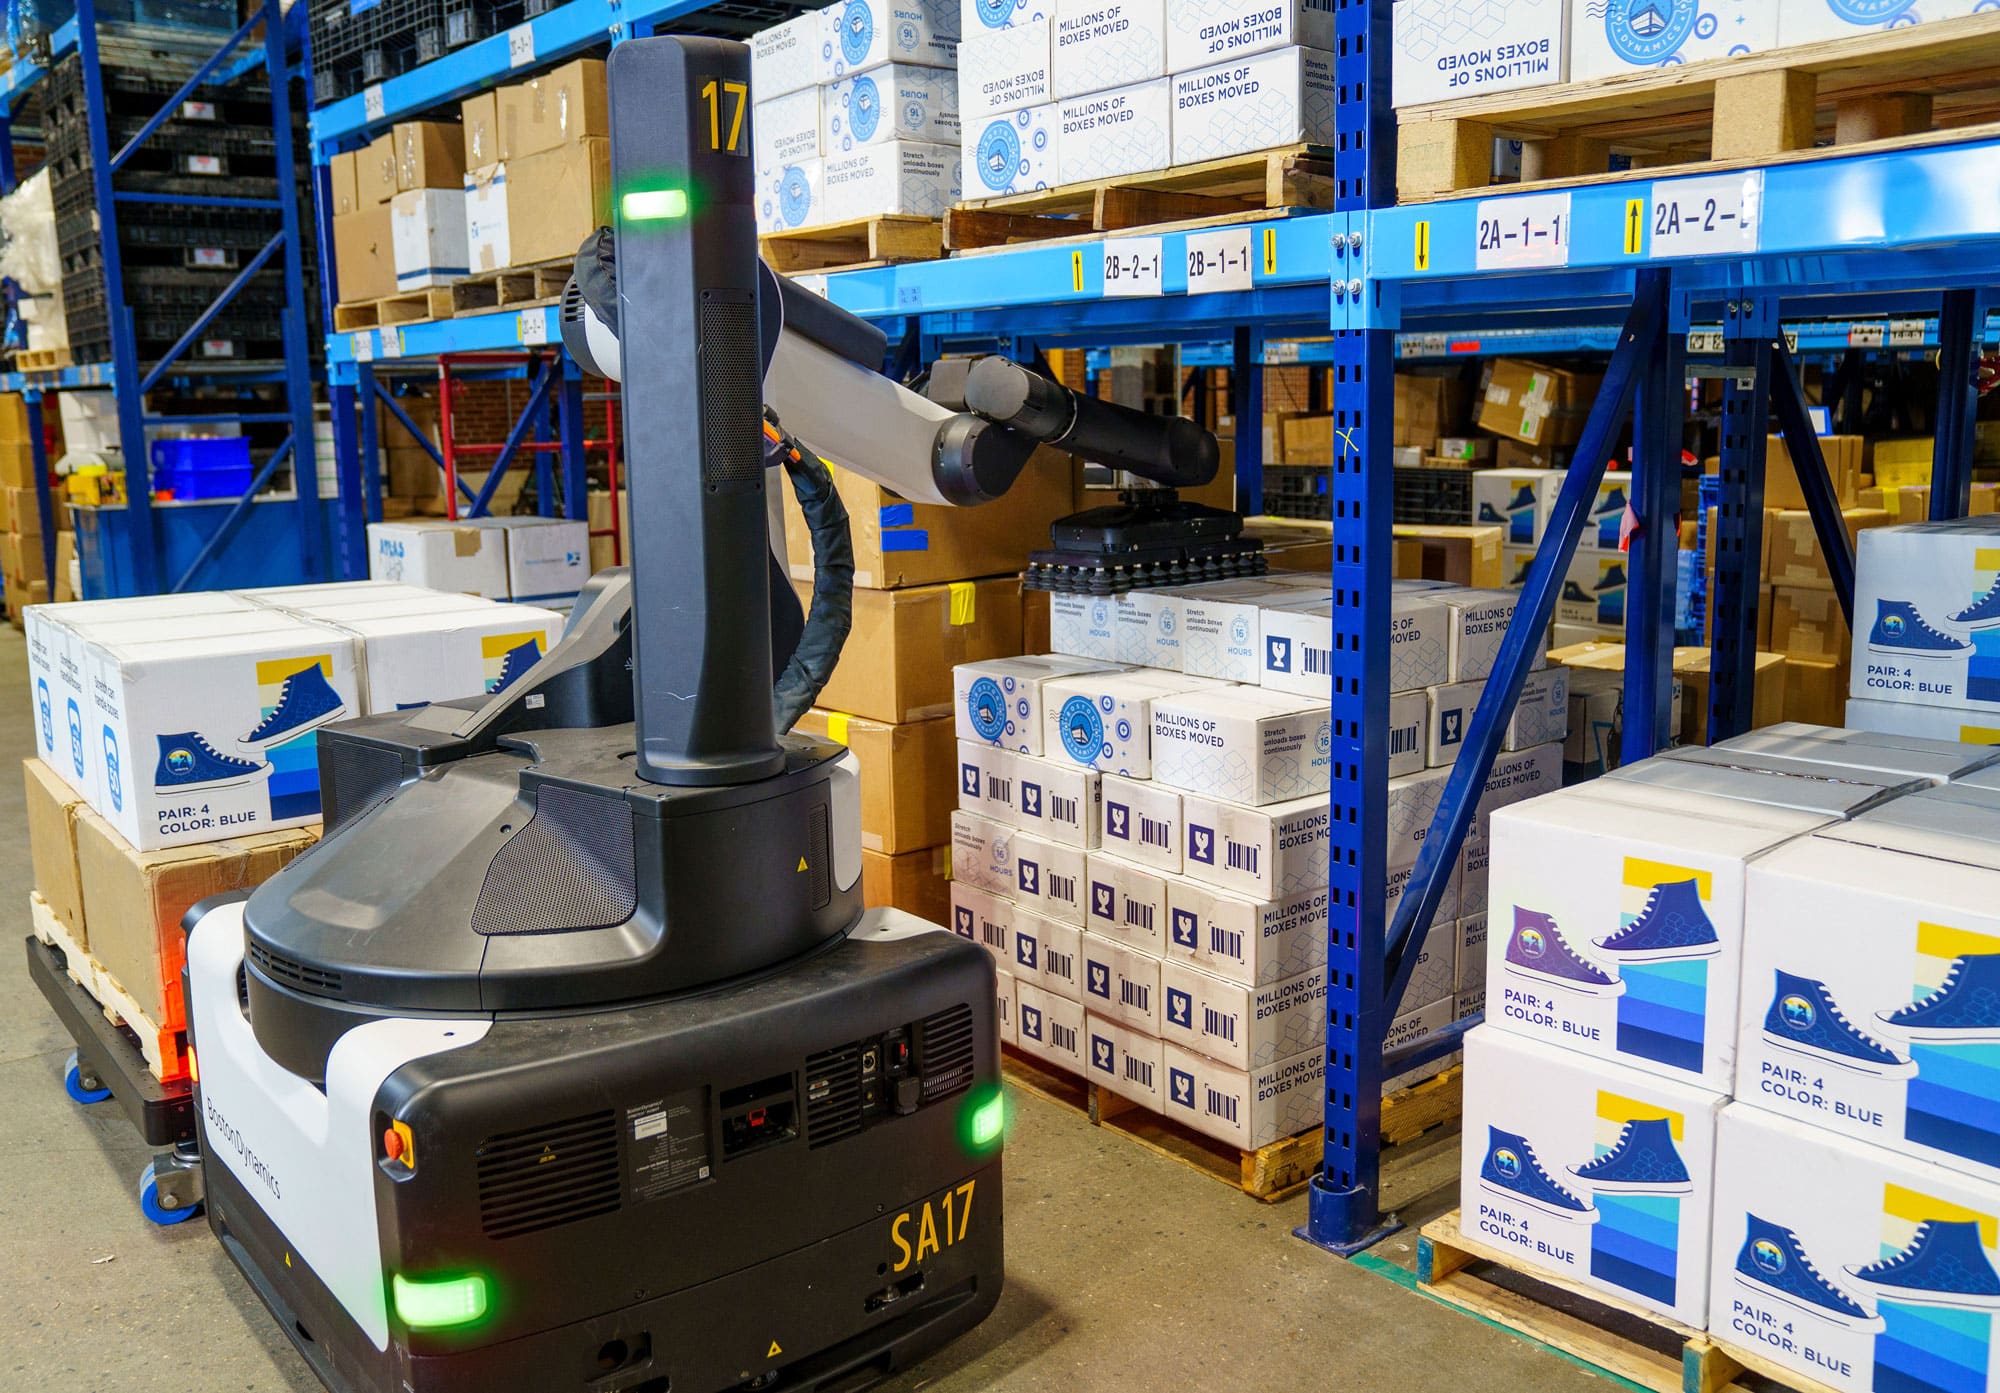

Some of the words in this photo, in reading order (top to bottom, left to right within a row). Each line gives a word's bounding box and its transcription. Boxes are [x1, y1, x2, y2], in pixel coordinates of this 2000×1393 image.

[1060, 11, 1104, 32] MILLIONS
[1108, 6, 1121, 20] OF
[1244, 6, 1282, 23] BOXES
[756, 30, 782, 45] MILLIONS
[784, 28, 792, 38] OF
[1060, 29, 1090, 46] BOXES
[1094, 19, 1129, 38] MOVED
[1200, 19, 1240, 40] MOVED
[1227, 23, 1282, 45] MILLIONS
[1620, 25, 1680, 53] DYNAMICS
[756, 44, 776, 59] BOXES
[776, 38, 797, 55] MOVED
[1208, 40, 1224, 54] OF
[1497, 38, 1550, 60] BOXES
[1305, 59, 1328, 70] Stretch
[1438, 48, 1492, 71] MOVED
[1016, 69, 1044, 86] BOXES
[1305, 70, 1330, 82] unloads
[1449, 71, 1470, 87] OF
[1475, 57, 1549, 82] MILLIONS
[982, 78, 1013, 95] MOVED
[1178, 72, 1230, 94] MILLIONS
[1234, 67, 1250, 82] OF
[990, 94, 1002, 106] OF
[1004, 84, 1044, 102] MILLIONS
[1179, 91, 1214, 110] BOXES
[1218, 81, 1260, 101] MOVED
[702, 80, 748, 152] 17
[1063, 100, 1108, 121] MILLIONS
[1112, 96, 1126, 110] OF
[1064, 117, 1094, 134] BOXES
[1098, 110, 1134, 127] MOVED
[826, 158, 857, 172] MILLIONS
[858, 156, 868, 168] OF
[902, 152, 924, 160] Stretch
[902, 160, 926, 168] unloads
[927, 161, 944, 170] boxes
[827, 172, 849, 185] BOXES
[850, 167, 874, 182] MOVED
[903, 168, 940, 178] continuously
[1480, 214, 1560, 250] 2A-1-1
[1106, 254, 1158, 280] 2B-2-1
[1189, 246, 1248, 277] 2B-1-1
[1400, 618, 1414, 630] OF
[1465, 608, 1505, 622] MILLIONS
[1162, 620, 1172, 630] 16
[1235, 628, 1244, 638] 16
[1466, 621, 1494, 636] BOXES
[1156, 638, 1180, 648] HOURS
[1228, 647, 1252, 657] HOURS
[1867, 665, 1900, 677] PAIR:
[1903, 668, 1912, 678] 4
[1867, 678, 1914, 690] COLOR:
[1918, 682, 1952, 694] BLUE
[1066, 704, 1096, 722] BOSTON
[1155, 712, 1200, 730] MILLIONS
[1202, 720, 1216, 732] OF
[1156, 724, 1186, 740] BOXES
[1189, 732, 1224, 748] MOVED
[1264, 728, 1286, 737] Stretch
[1264, 736, 1288, 747] unloads
[1288, 733, 1306, 742] boxes
[1320, 737, 1329, 746] 16
[1067, 736, 1097, 755] DYNAMICS
[1264, 742, 1302, 756] continuously
[1524, 760, 1536, 770] OF
[1485, 779, 1511, 792] BOXES
[1512, 770, 1540, 784] MOVED
[158, 806, 196, 821] PAIR:
[200, 804, 210, 814] 4
[160, 818, 216, 835] COLOR:
[220, 811, 256, 826] BLUE
[1279, 814, 1328, 836] MILLIONS
[1280, 833, 1314, 850] BOXES
[1468, 846, 1489, 860] MILLI
[1468, 858, 1489, 872] BOXE
[1264, 900, 1310, 924] MILLIONS
[1314, 895, 1327, 908] OF
[1264, 920, 1297, 938] BOXES
[1300, 907, 1328, 926] MOVE
[1466, 920, 1488, 935] MILLI
[1466, 932, 1488, 948] BOXE
[1256, 982, 1304, 1006] MILLIONS
[1307, 974, 1321, 990] OF
[1460, 991, 1486, 1008] MILLIO
[1504, 988, 1540, 1008] PAIR:
[1544, 1000, 1554, 1012] 4
[1257, 1000, 1290, 1020] BOXES
[1409, 1016, 1422, 1030] OF
[1504, 1006, 1558, 1030] COLOR:
[1563, 1020, 1600, 1041] BLUE
[1258, 1064, 1305, 1088] MILLIONS
[1308, 1055, 1322, 1072] OF
[1761, 1061, 1807, 1086] PAIR:
[1813, 1078, 1824, 1090] 4
[1258, 1082, 1292, 1102] BOXES
[1761, 1080, 1828, 1110] COLOR:
[1835, 1102, 1884, 1127] BLUE
[207, 1097, 281, 1200] BostonDynamics
[891, 1178, 976, 1272] SA17
[1480, 1204, 1516, 1227] PAIR:
[1520, 1220, 1529, 1231] 4
[1480, 1220, 1532, 1248] COLOR:
[1537, 1242, 1574, 1264] BLUE
[1734, 1300, 1777, 1328] PAIR:
[1783, 1322, 1794, 1335] 4
[1732, 1318, 1798, 1354] COLOR:
[1804, 1347, 1852, 1378] BLUE
